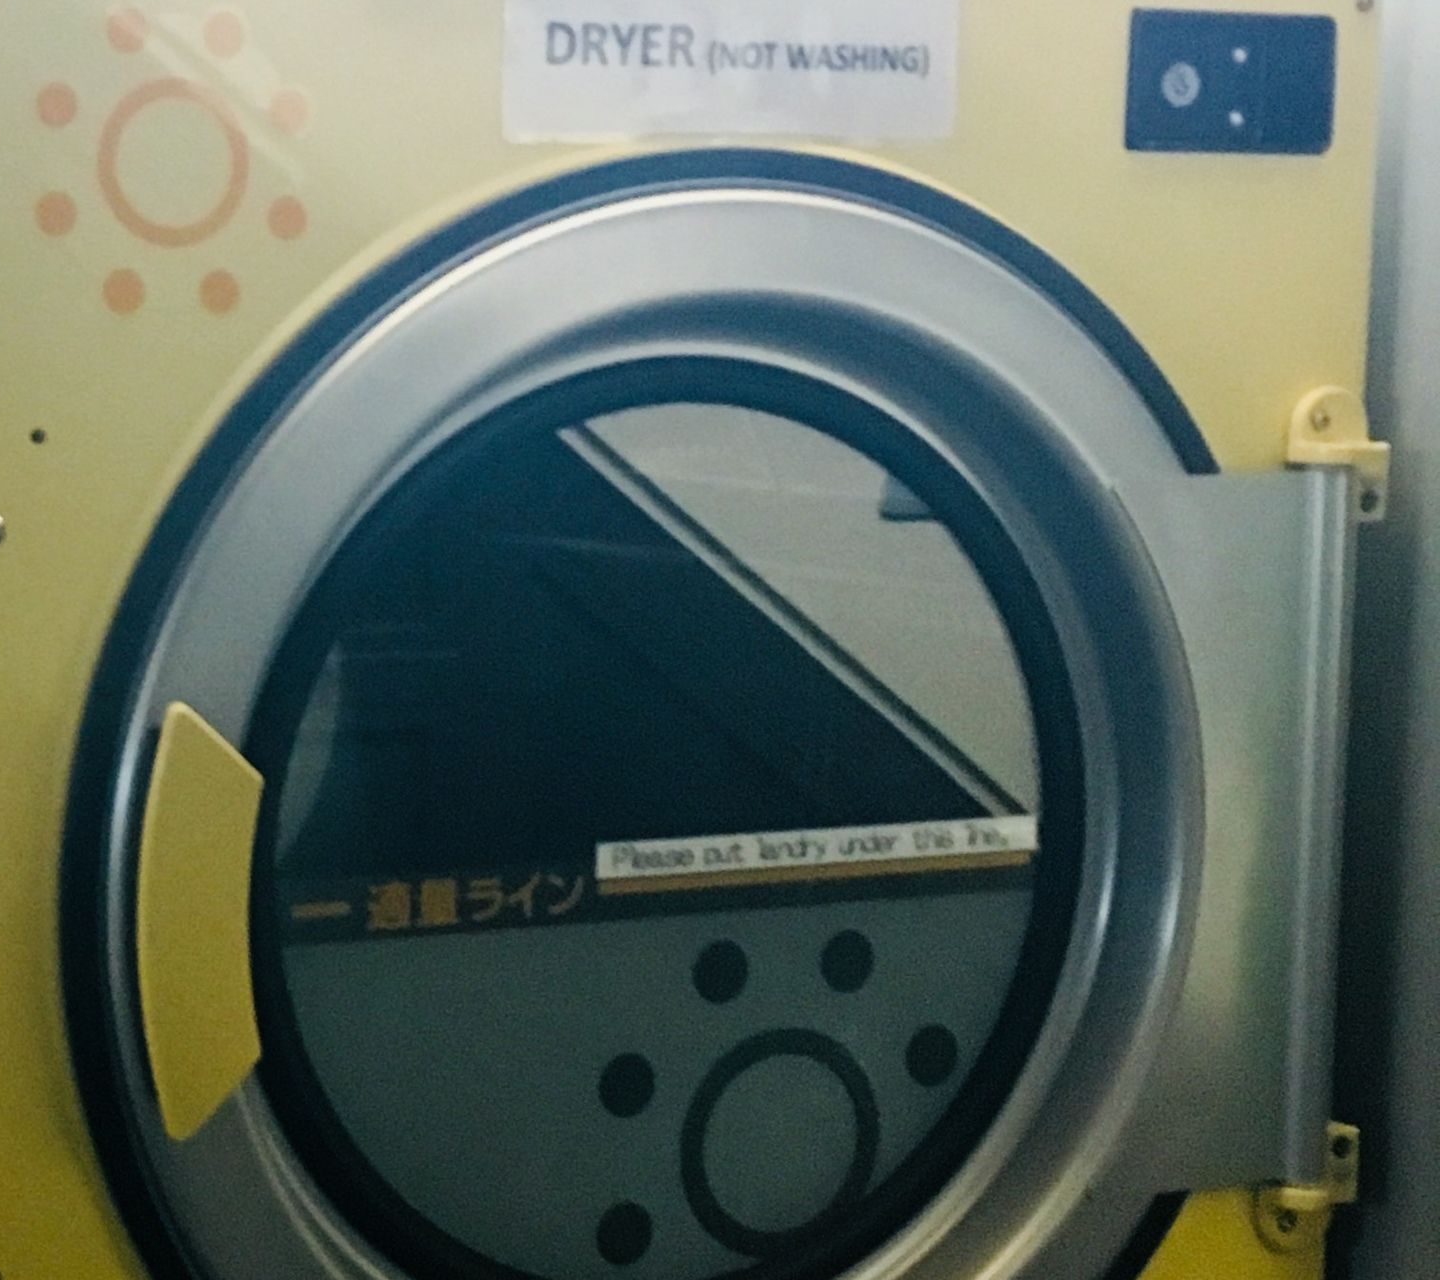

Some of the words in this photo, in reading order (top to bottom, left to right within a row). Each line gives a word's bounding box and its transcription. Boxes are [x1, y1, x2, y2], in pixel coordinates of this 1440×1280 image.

[545, 22, 695, 67] DRYER
[708, 39, 778, 74] (NOT
[787, 44, 930, 77] WASHING)
[611, 843, 694, 870] Please
